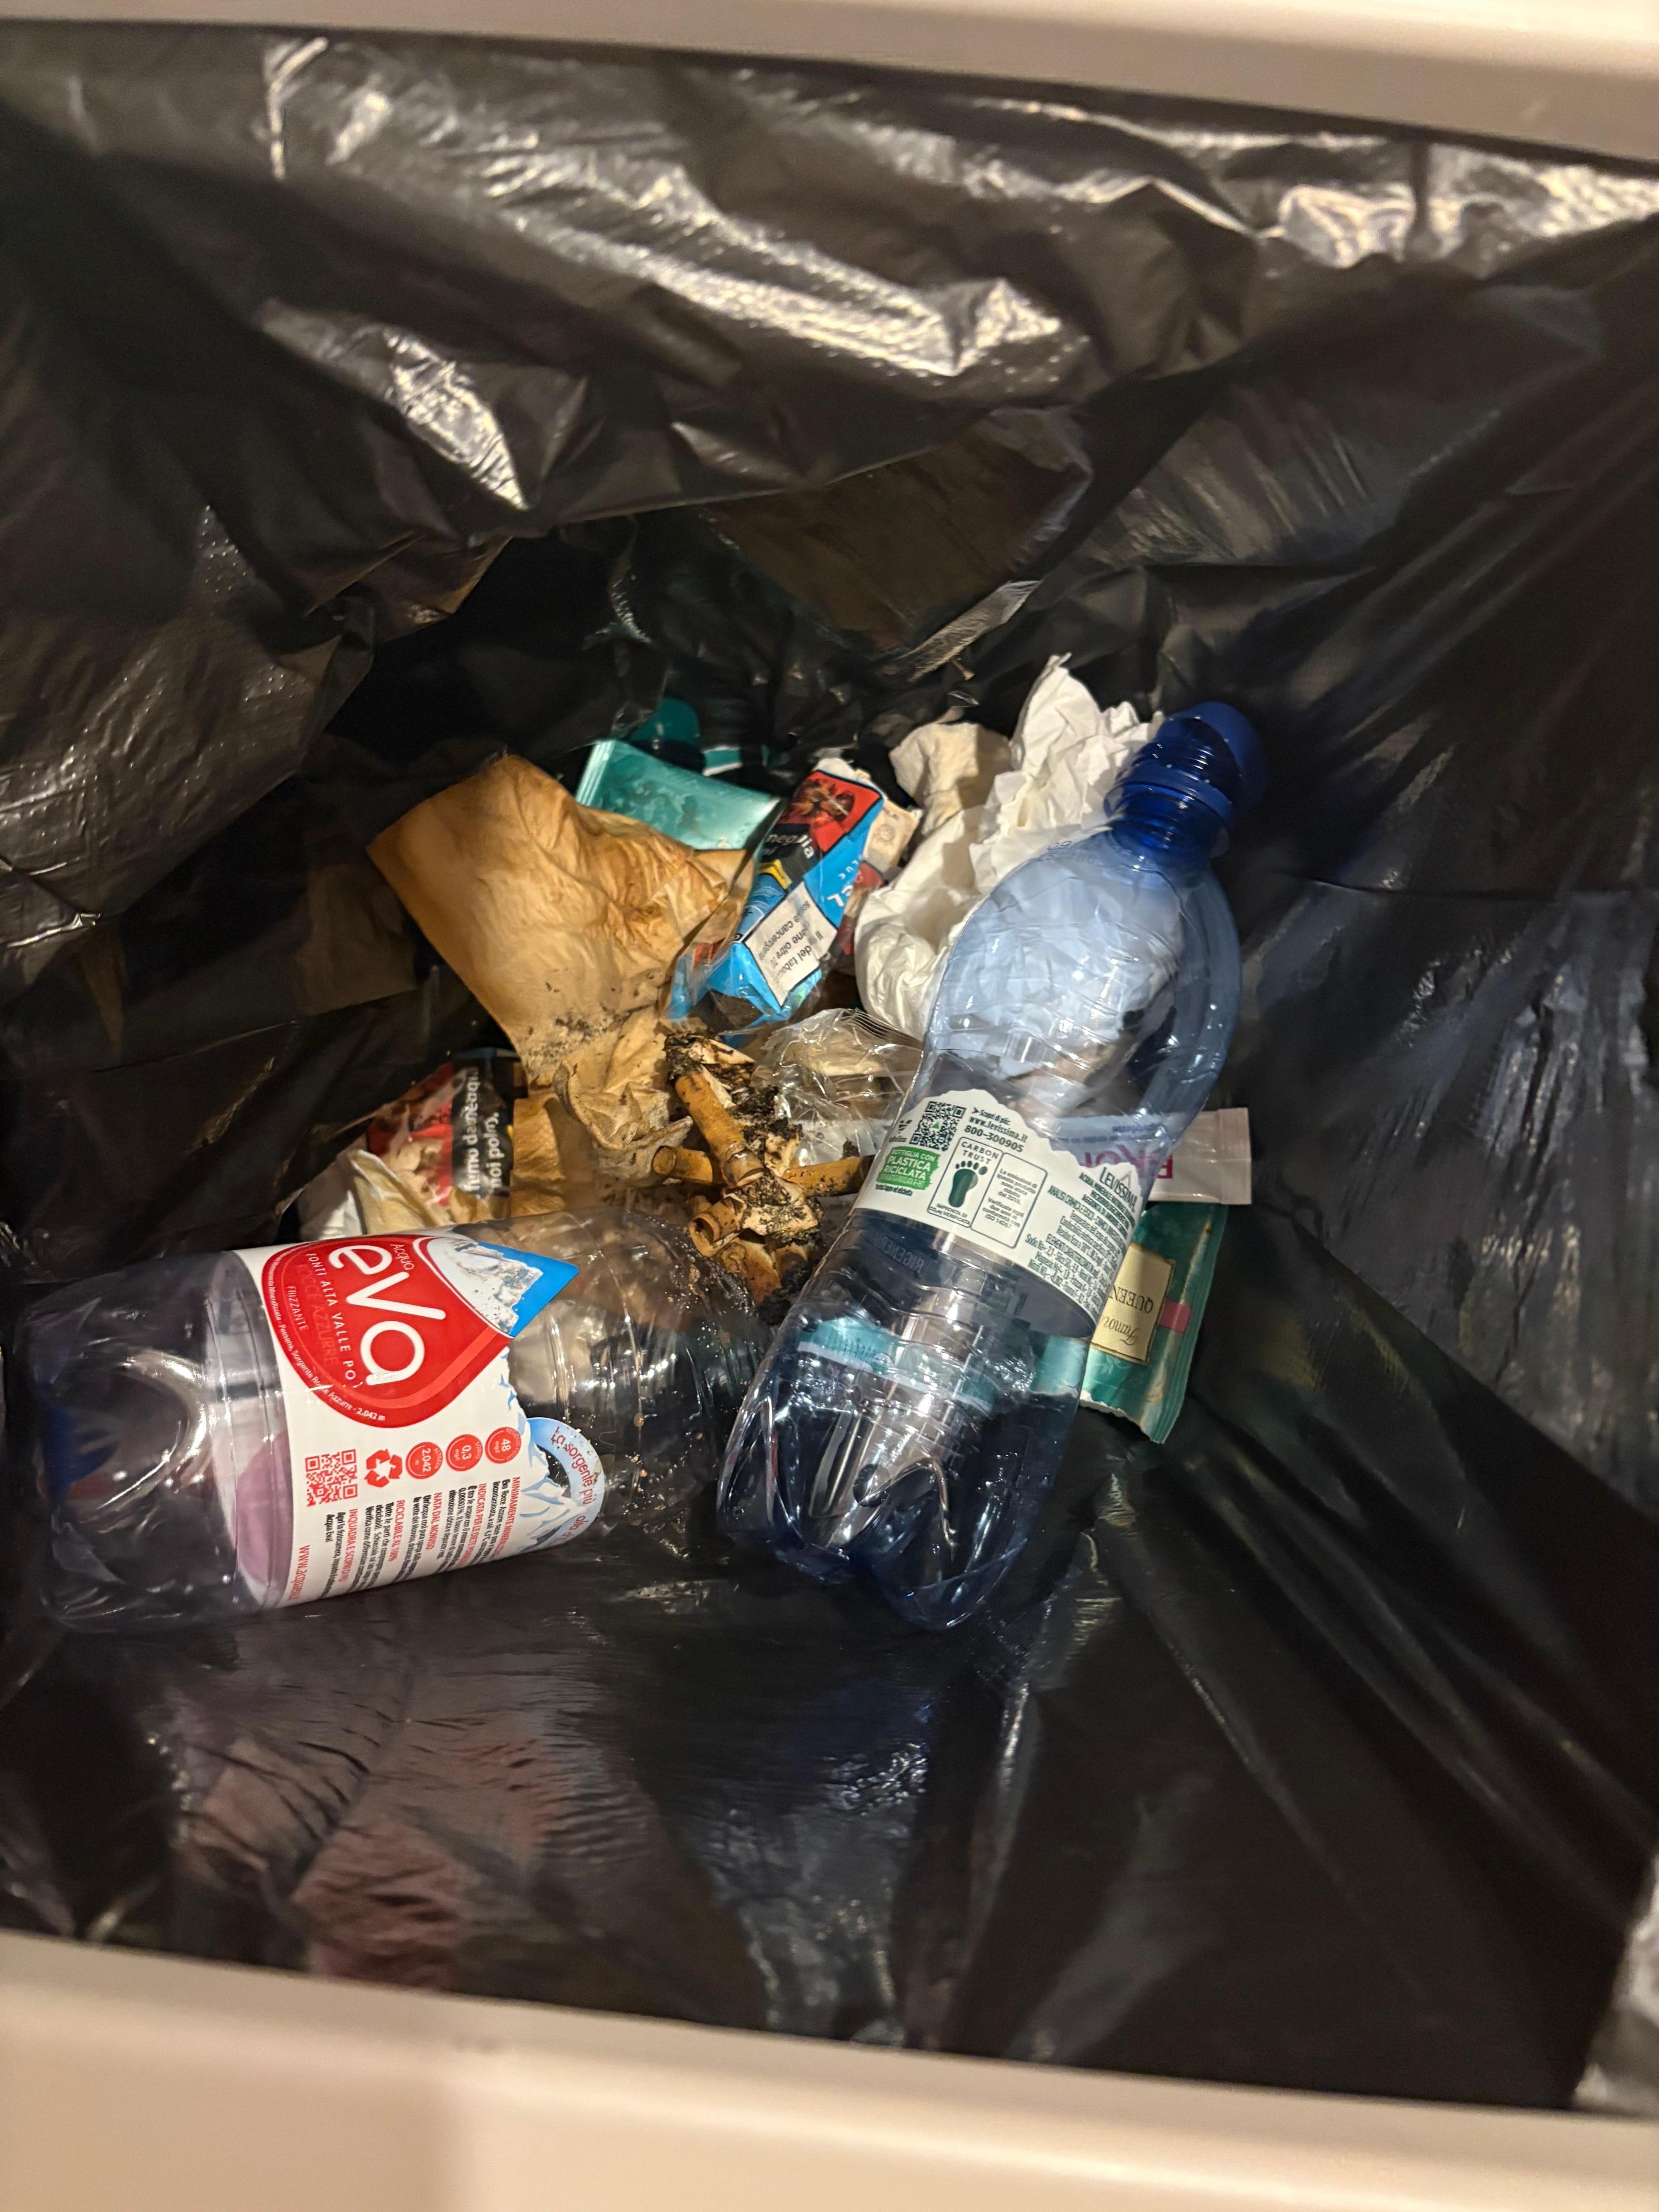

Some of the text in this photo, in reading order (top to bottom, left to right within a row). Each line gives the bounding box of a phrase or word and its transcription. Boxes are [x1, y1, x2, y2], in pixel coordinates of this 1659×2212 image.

[774, 941, 793, 960] oltre
[796, 945, 814, 961] del
[968, 1115, 1029, 1142] www.levissima.it
[964, 1126, 1024, 1151] 800-300905
[960, 1141, 999, 1159] CARBON
[962, 1151, 991, 1164] TRUST
[888, 1153, 931, 1171] PLASTICA
[884, 1164, 925, 1180] RICICLATA
[1101, 1167, 1139, 1213] LEVISSIMA
[390, 1243, 415, 1269] Acqua
[287, 1286, 309, 1330] FRIZZANTE
[1108, 1284, 1154, 1314] QUEEN
[306, 1253, 356, 1380] FONTI ALTA VALLE PO
[292, 1350, 313, 1379] Sorgente
[357, 1408, 378, 1420] 2.042
[461, 1445, 472, 1460] 0,3
[501, 1439, 512, 1452] 48
[421, 1448, 431, 1472] 2.042
[434, 1448, 442, 1469] ALTEZZA
[551, 1426, 566, 1444] La
[564, 1442, 594, 1487] sorgente
[580, 1488, 596, 1504] più
[501, 1479, 510, 1489] Eva
[476, 1483, 487, 1514] INDICATA
[500, 1490, 508, 1504] Rocce
[505, 1477, 520, 1525] MINIMAMENTE
[364, 1505, 374, 1526] Verifica
[384, 1501, 394, 1517] Tutte
[412, 1503, 421, 1516] vette
[420, 1494, 431, 1519] Un'acqua
[464, 1505, 474, 1519] acque
[497, 1506, 506, 1523] Azzurre
[324, 1514, 335, 1531] Acqua
[335, 1512, 346, 1524] Apri
[346, 1508, 358, 1545] INQUADRA
[392, 1499, 405, 1539] RICICLABILE
[421, 1519, 429, 1529] così
[426, 1492, 442, 1550] NATA DAL MONVISO
[446, 1516, 454, 1528] idrica
[453, 1520, 462, 1532] basso
[473, 1515, 483, 1525] PER
[381, 1525, 391, 1537] parti
[417, 1529, 426, 1539] pura
[468, 1532, 479, 1546] DIETE
[333, 1530, 344, 1558] fotocamera,
[392, 1539, 398, 1547] AL
[342, 1551, 353, 1570] SCOPRI
[388, 1547, 398, 1562] 100%
